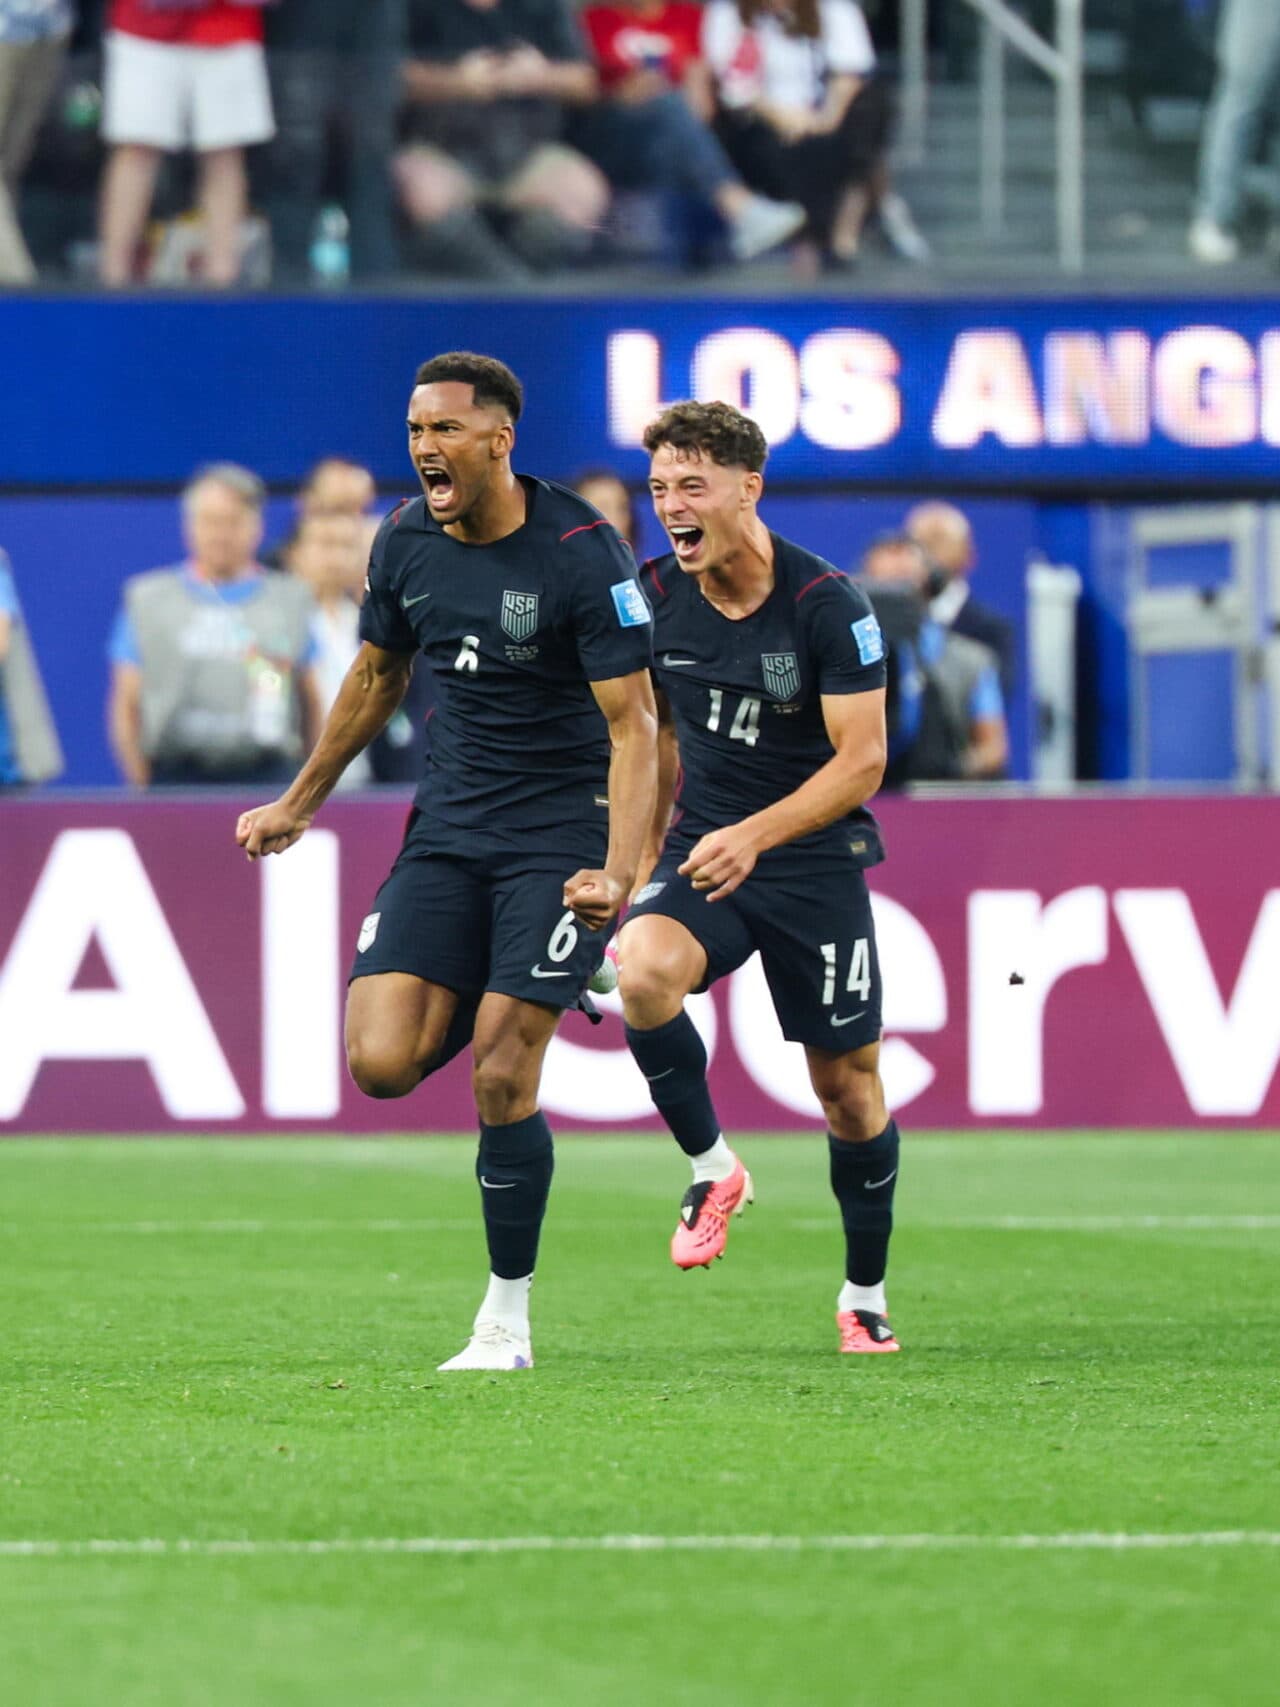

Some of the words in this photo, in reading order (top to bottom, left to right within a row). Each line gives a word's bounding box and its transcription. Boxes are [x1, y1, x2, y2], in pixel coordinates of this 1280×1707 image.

[606, 327, 901, 451] LOS
[505, 593, 536, 615] USA
[764, 656, 795, 676] USA
[707, 688, 763, 748] 14
[547, 910, 578, 963] 6
[820, 937, 872, 1005] 14
